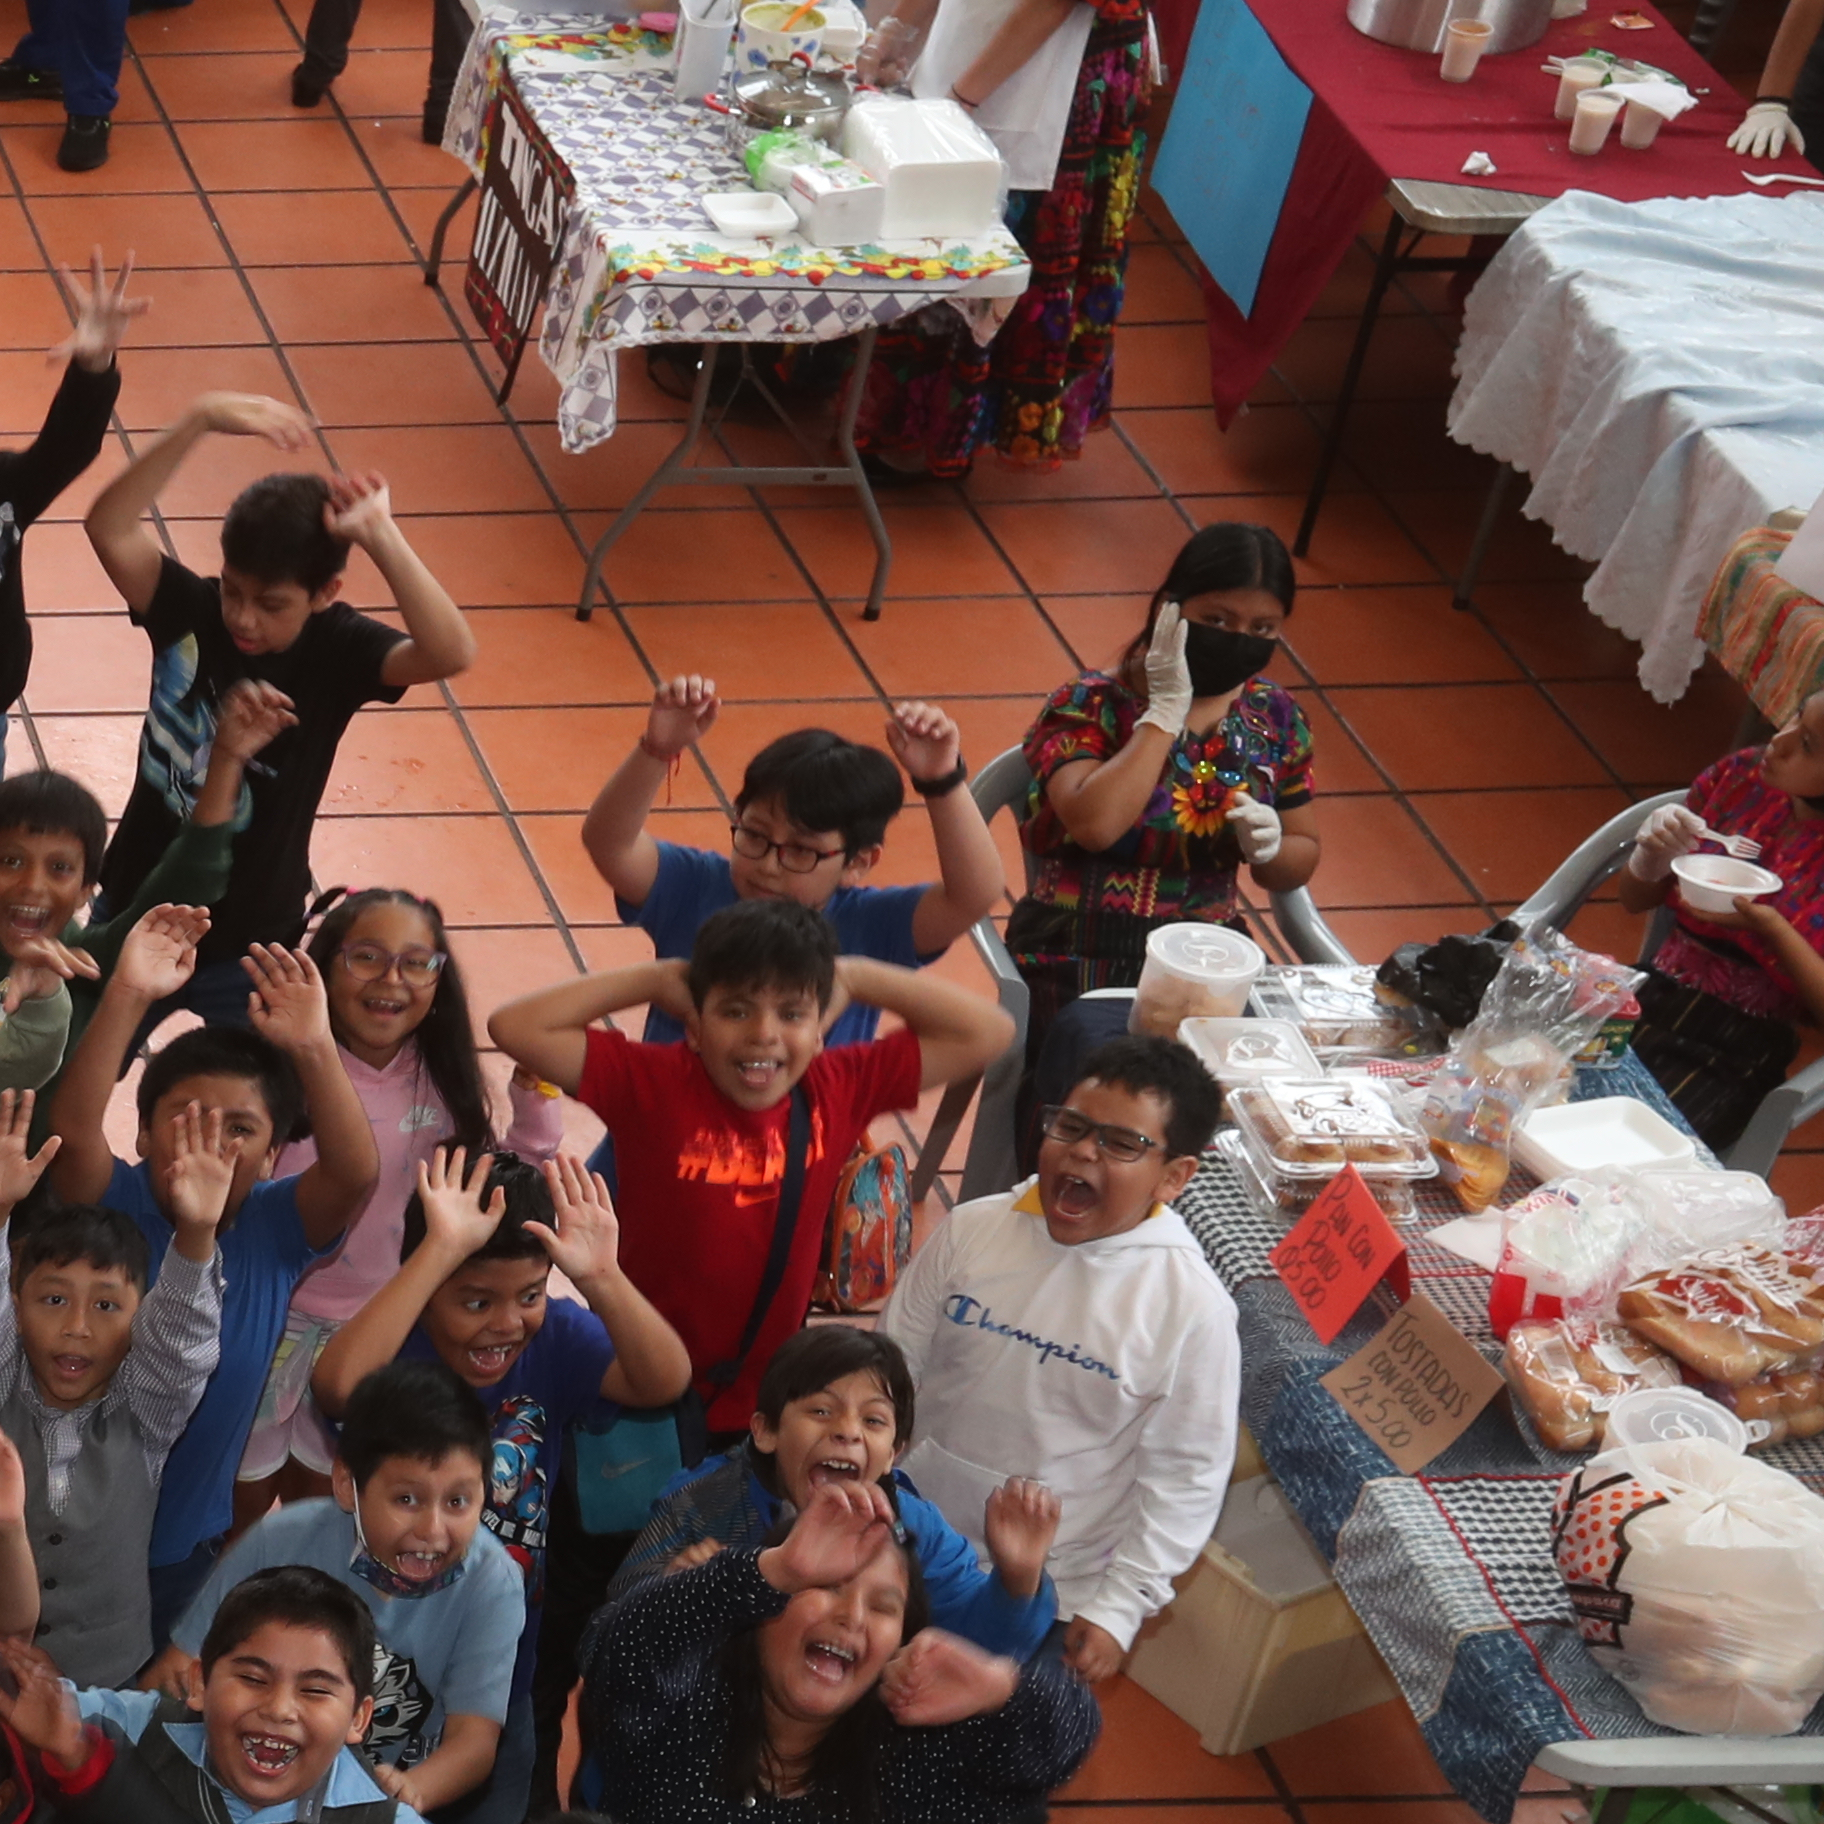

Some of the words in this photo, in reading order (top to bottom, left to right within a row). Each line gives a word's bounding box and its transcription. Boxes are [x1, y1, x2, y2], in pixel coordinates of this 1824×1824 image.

[942, 1294, 1121, 1380] Champion
[1385, 1310, 1473, 1420] TOSTADAS
[1368, 1350, 1400, 1390] CON
[1395, 1380, 1439, 1428] POLLO
